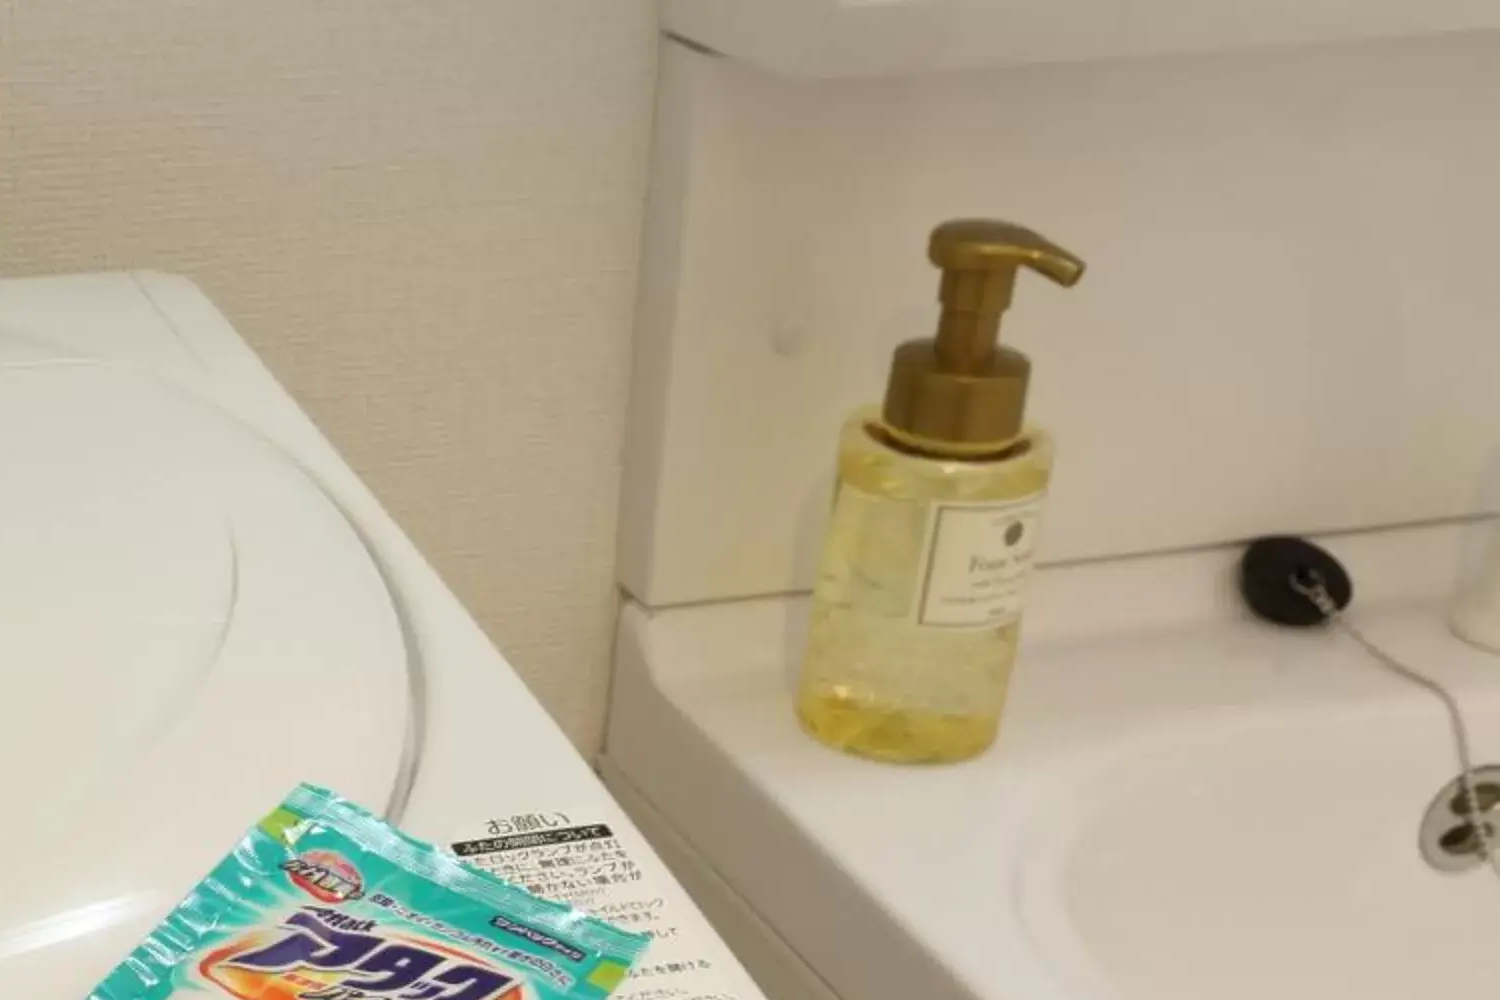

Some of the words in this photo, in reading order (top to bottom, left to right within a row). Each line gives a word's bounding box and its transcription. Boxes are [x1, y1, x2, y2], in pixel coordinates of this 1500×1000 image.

[485, 812, 571, 835] お願い
[302, 905, 378, 933] Attack
